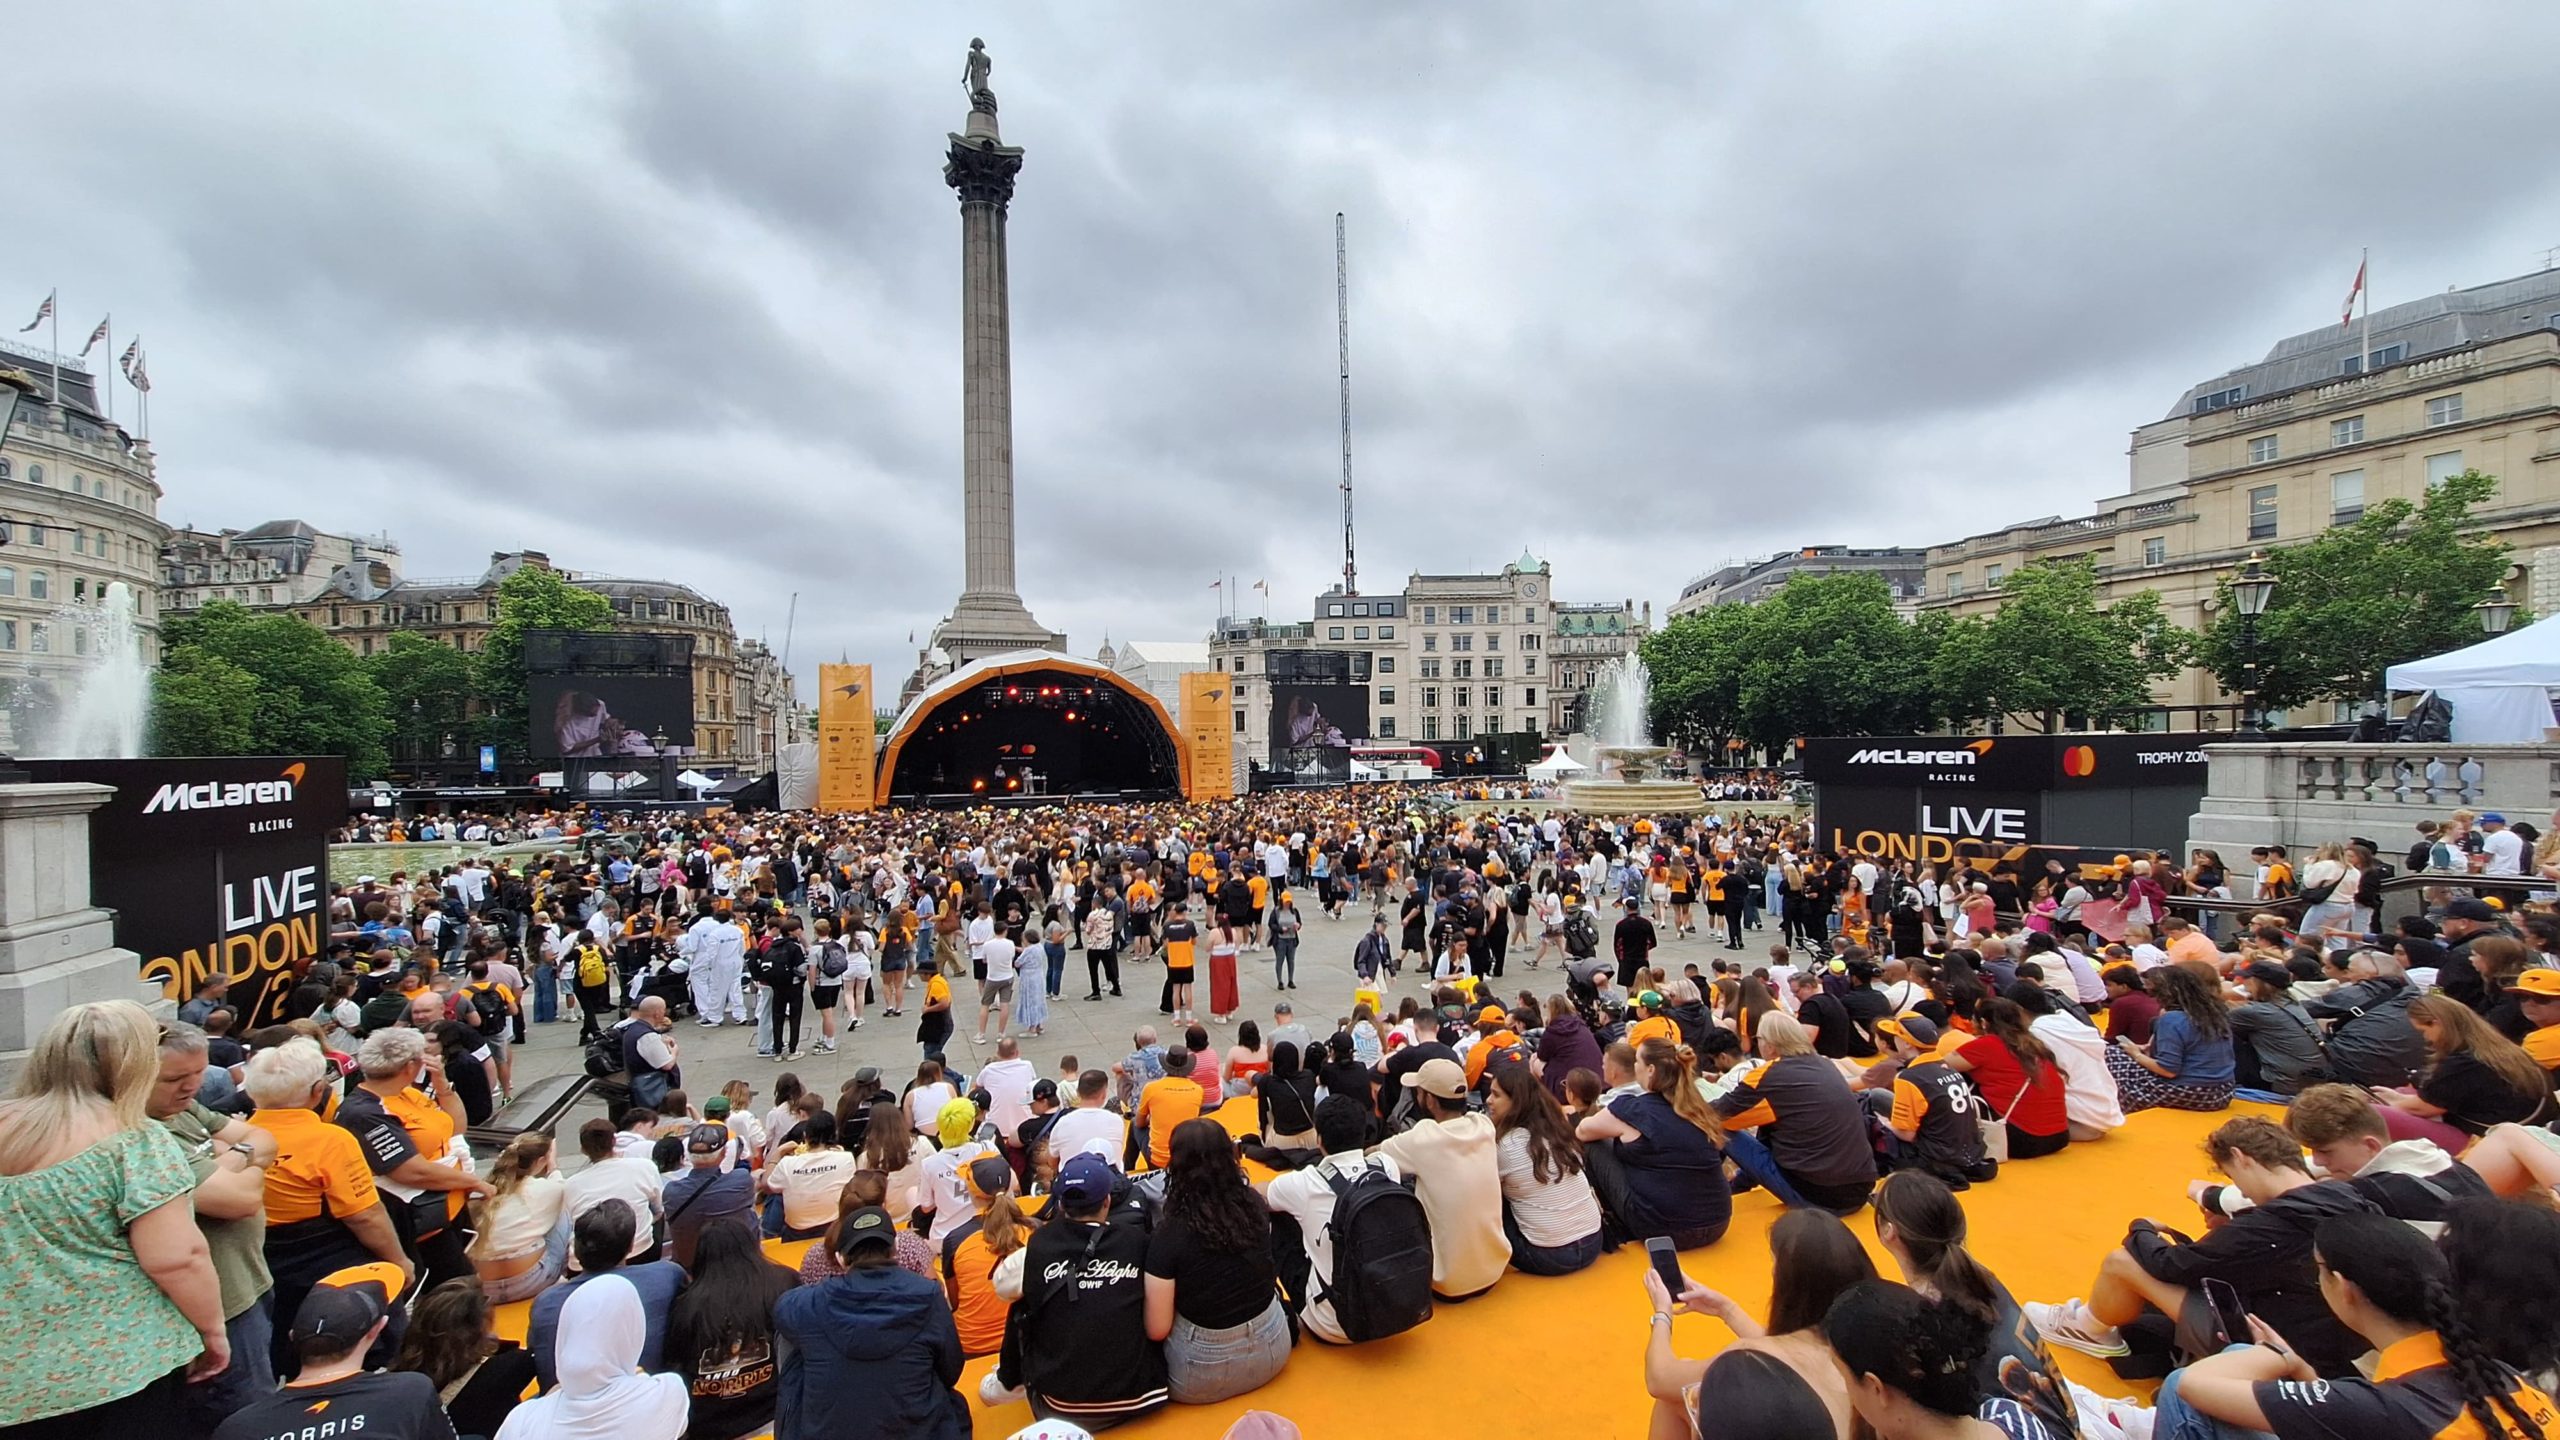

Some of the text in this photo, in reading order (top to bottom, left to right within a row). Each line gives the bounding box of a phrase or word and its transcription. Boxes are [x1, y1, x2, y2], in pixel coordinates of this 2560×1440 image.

[1847, 749, 1976, 765] McLaren
[2136, 751, 2209, 765] TROPHY ZON
[1929, 773, 1976, 782] RACING
[143, 780, 292, 813] McLaren
[249, 818, 293, 834] RACING
[1922, 805, 2026, 839] LIVE
[225, 865, 317, 932] LIVE
[140, 912, 318, 1002] ONDON
[246, 969, 294, 1030] /2
[1086, 1259, 1139, 1285] Heights
[263, 1414, 366, 1440] ORRIS
